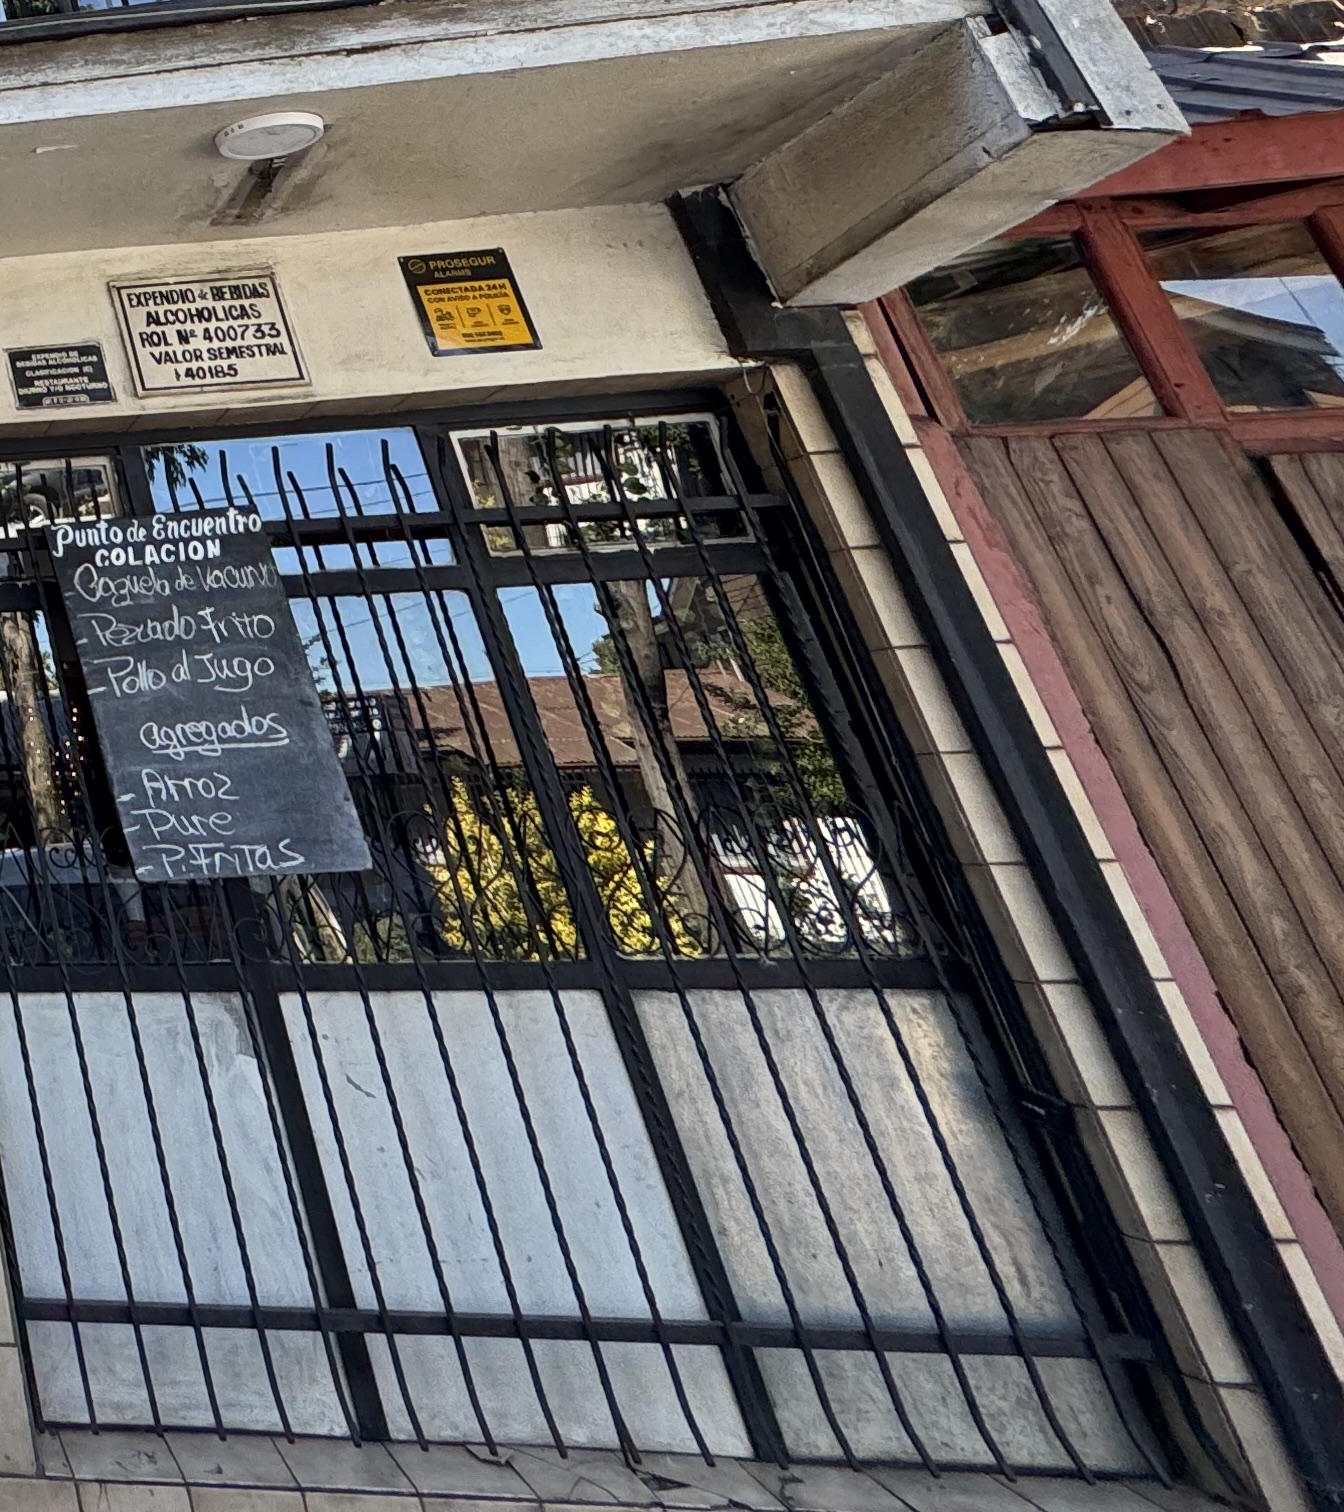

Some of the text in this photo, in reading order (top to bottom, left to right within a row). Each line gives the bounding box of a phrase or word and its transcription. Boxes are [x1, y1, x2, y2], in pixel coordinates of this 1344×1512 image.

[428, 256, 496, 270] PROSEGUR
[127, 282, 270, 308] EXPENDIO de BEBIDAS
[424, 284, 485, 296] CONECTADA
[447, 295, 471, 303] AVISO
[146, 303, 262, 327] ALCOHOLICAS
[139, 330, 173, 348] ROL
[202, 322, 281, 343] 400733
[149, 342, 288, 365] VALOR SEMESTRAL
[51, 507, 261, 557] Punto de Encuentro
[95, 539, 221, 567] COLACION
[94, 649, 275, 697] Pollo al Jugo
